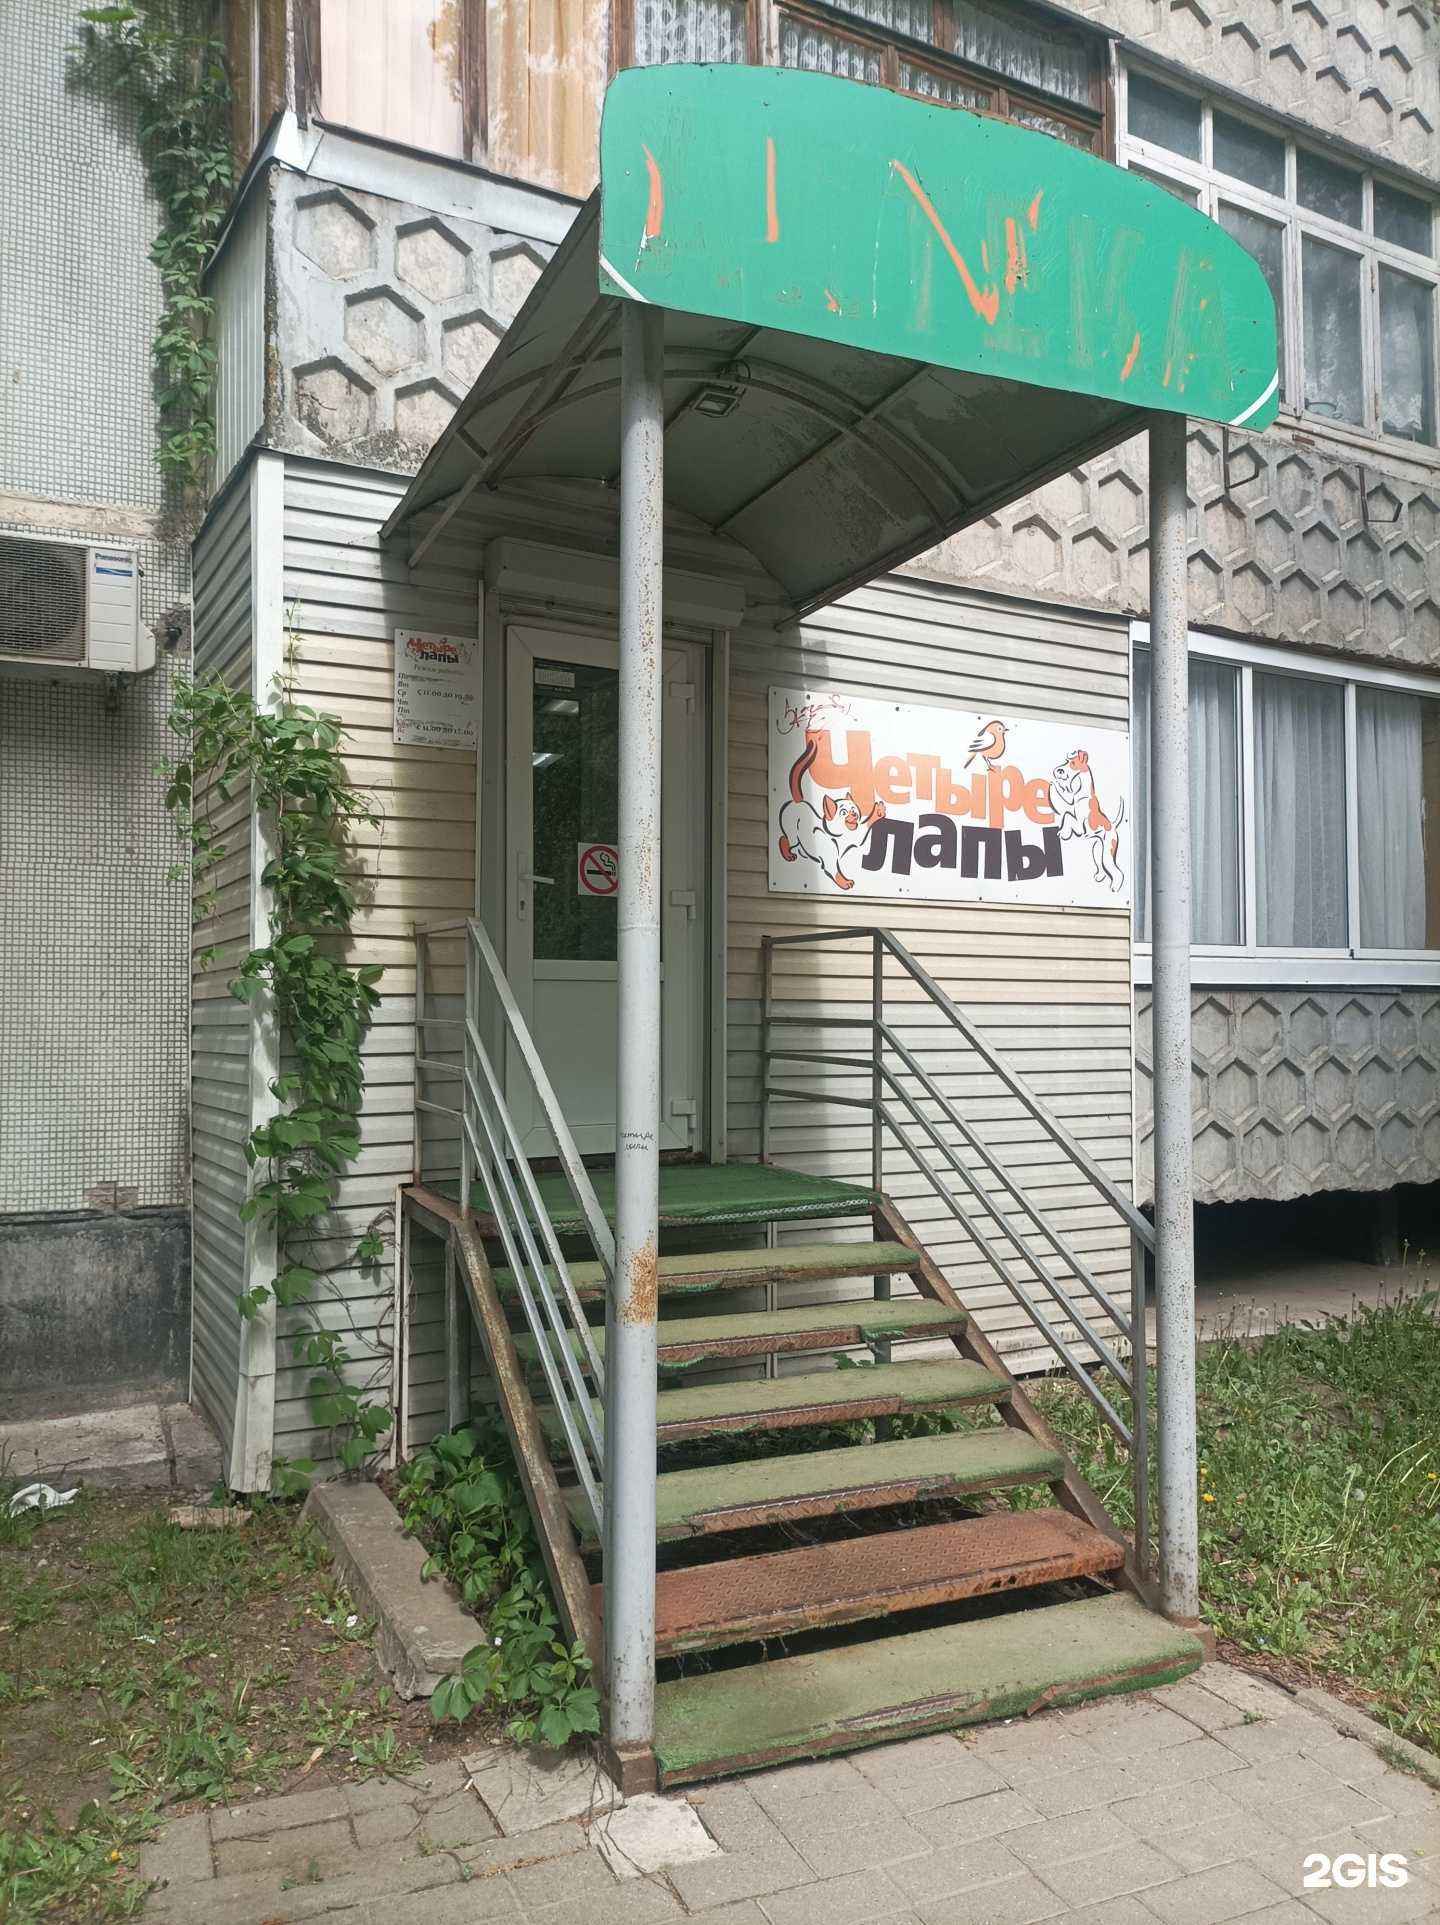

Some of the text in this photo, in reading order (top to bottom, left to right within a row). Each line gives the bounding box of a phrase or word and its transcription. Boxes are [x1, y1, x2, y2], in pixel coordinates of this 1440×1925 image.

[419, 651, 459, 664] лапы
[806, 730, 1055, 829] Четыре
[862, 814, 1064, 882] лапы
